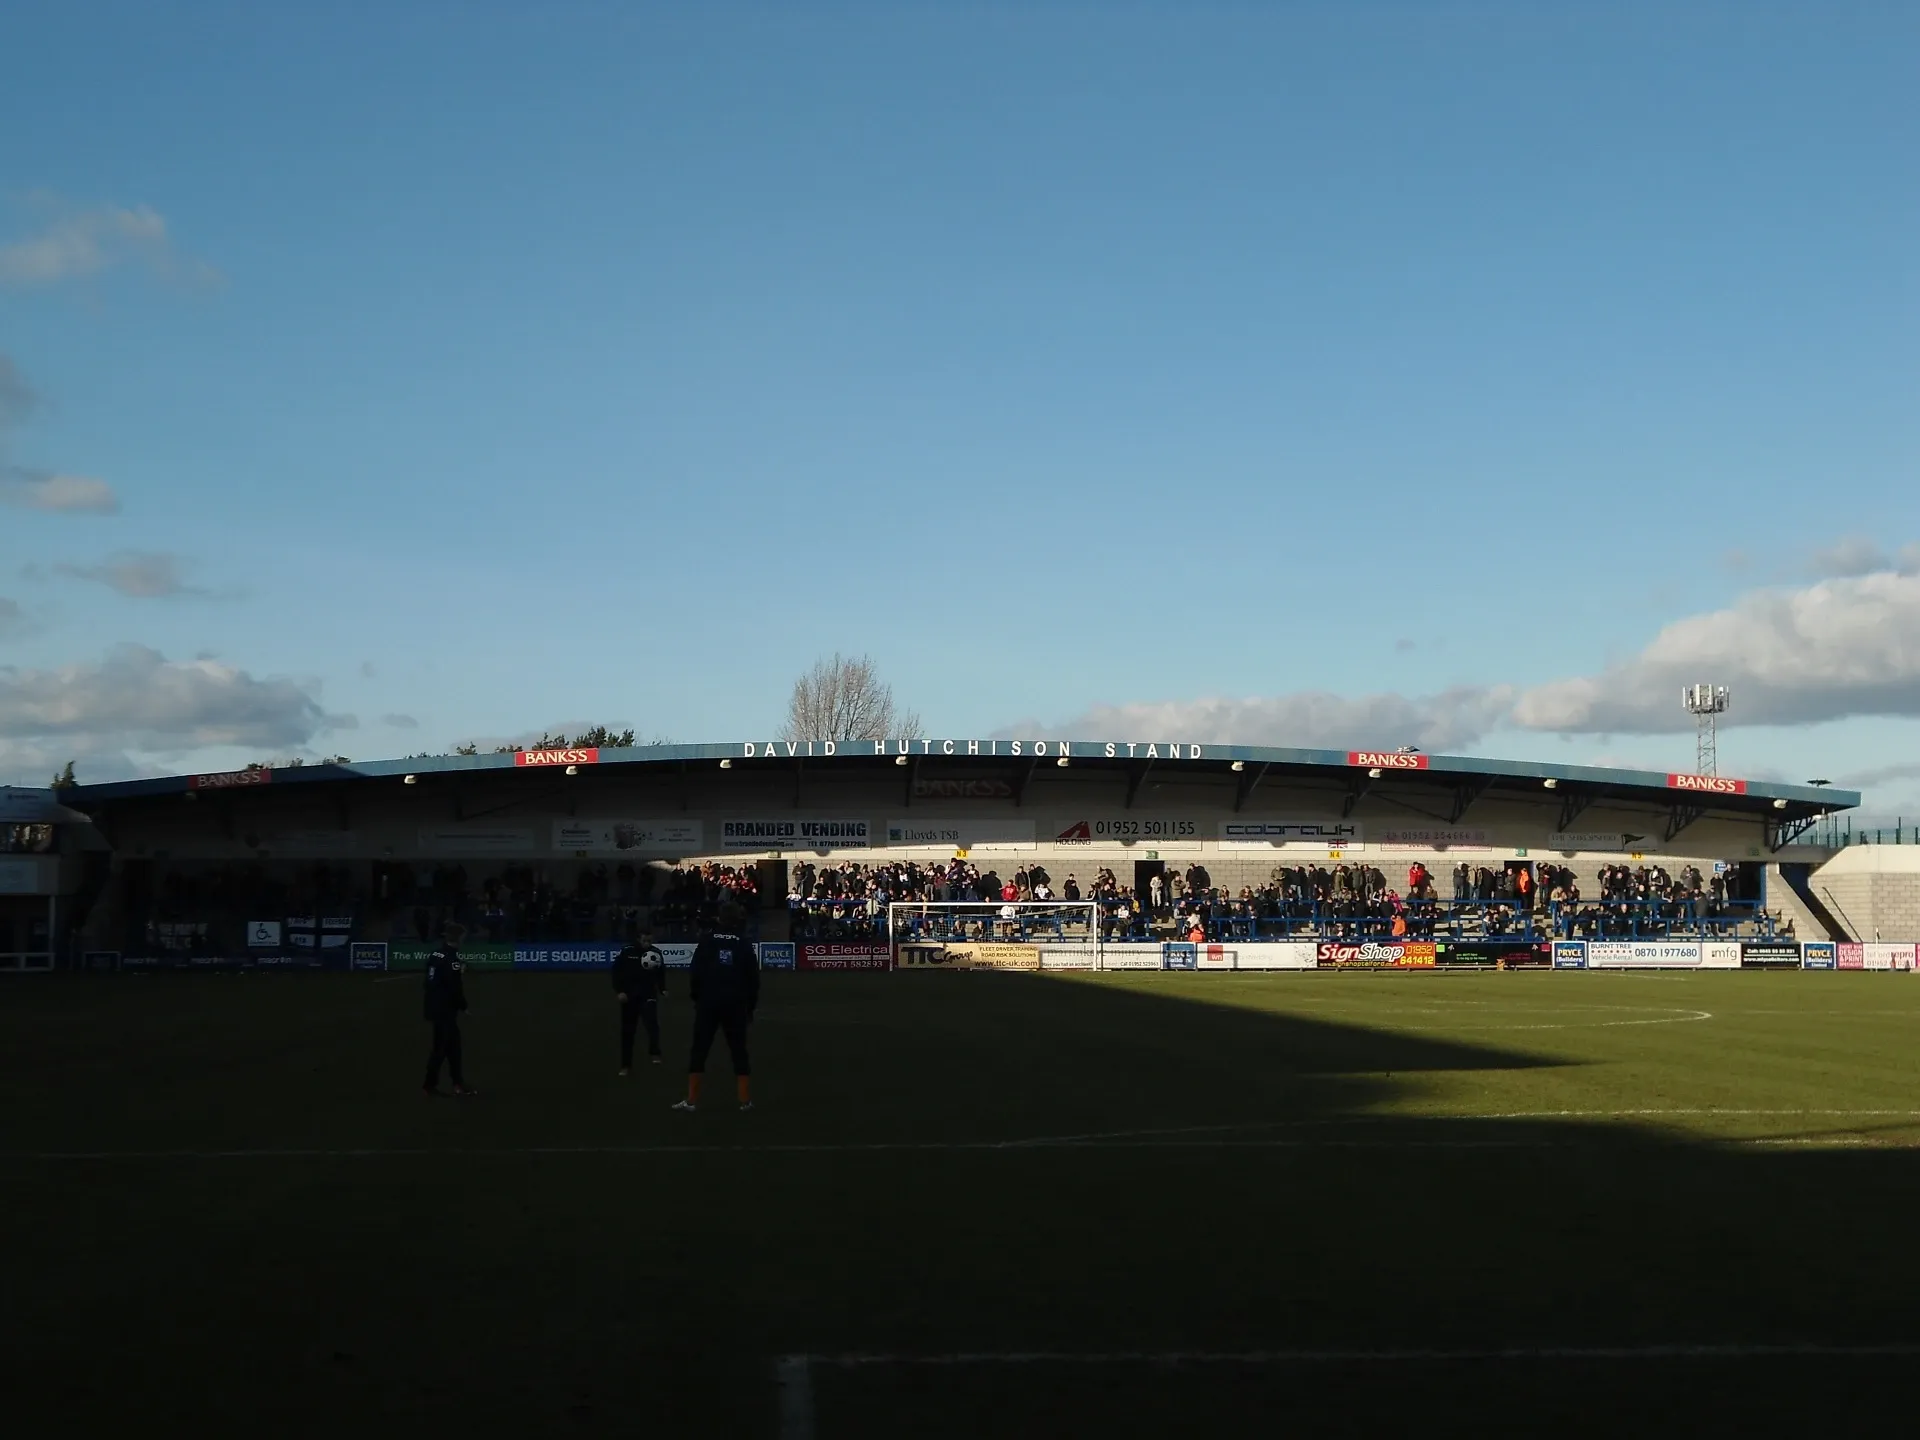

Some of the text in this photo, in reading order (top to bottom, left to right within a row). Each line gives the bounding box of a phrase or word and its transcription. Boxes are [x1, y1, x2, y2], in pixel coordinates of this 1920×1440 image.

[744, 740, 1201, 759] DAVID HUTCHISON STAND
[525, 750, 588, 764] BANKS'S
[1358, 753, 1418, 768] BANKS'S
[1677, 775, 1736, 791] BANKS'S
[725, 823, 867, 837] BRANDED VENDING
[1096, 821, 1195, 835] 01952 501155
[905, 830, 959, 843] Lloyds TSB
[764, 950, 790, 958] PRYCE
[805, 945, 826, 955] SG
[1406, 946, 1433, 955] 01952
[1557, 949, 1583, 957] PRYCE
[1634, 948, 1698, 958] 0870 1977680
[1807, 949, 1832, 957] PRYCE
[393, 952, 411, 961] The
[490, 952, 513, 962] Trust
[514, 951, 548, 962] BLUE
[551, 951, 607, 963] SQUARE
[901, 947, 945, 965] TTC
[1400, 956, 1434, 965] 641412
[821, 961, 883, 969] 07971 582893
[975, 960, 1038, 968] www.ttc-uk.com
